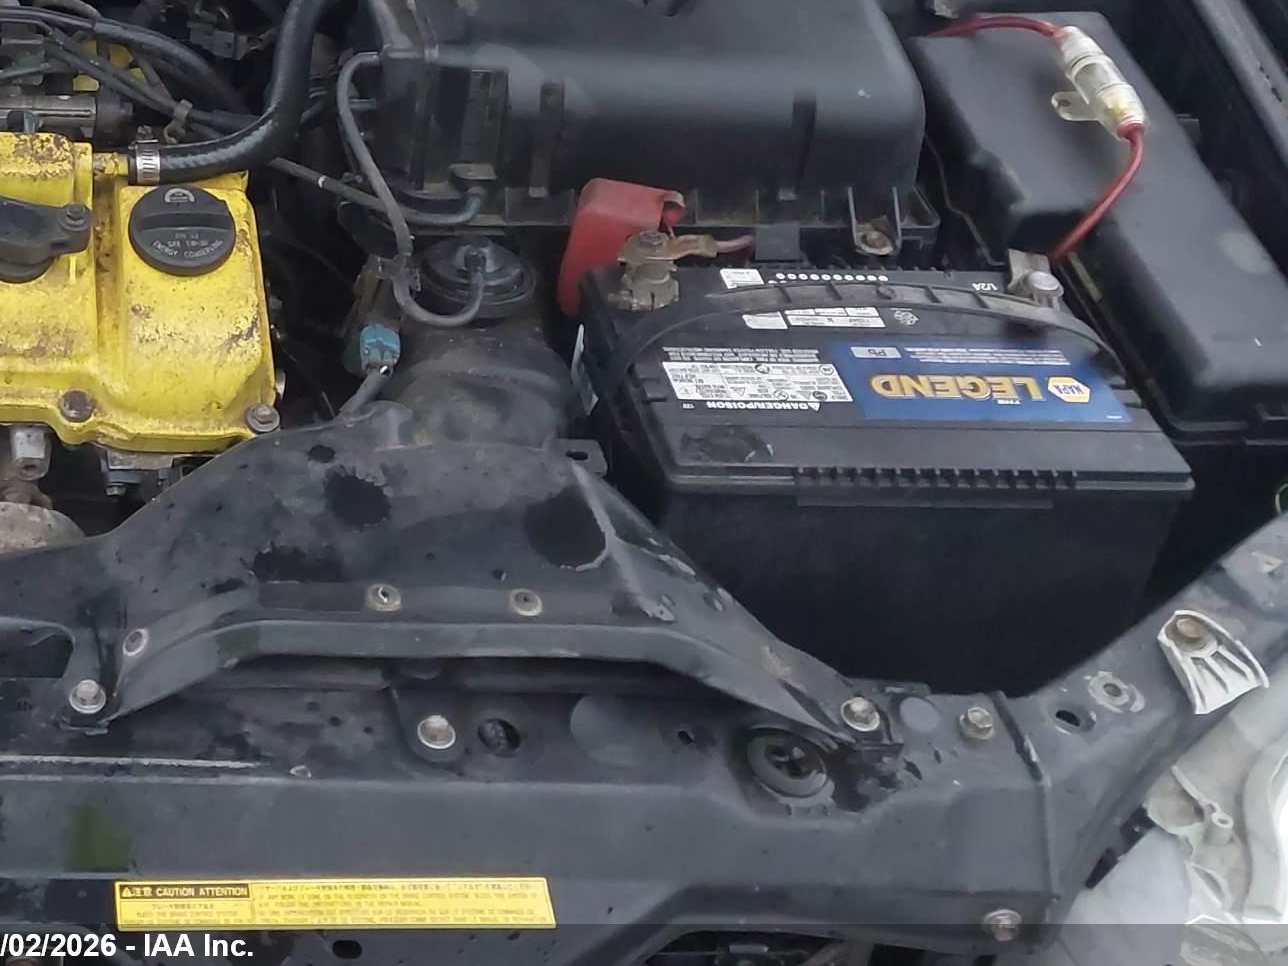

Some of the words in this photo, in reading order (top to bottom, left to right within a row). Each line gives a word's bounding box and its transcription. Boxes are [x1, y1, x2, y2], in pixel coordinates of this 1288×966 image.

[867, 348, 886, 357] Pb
[871, 374, 1047, 402] LEGEND
[1050, 384, 1084, 397] NAPA
[706, 401, 808, 410] DANGER/POISON
[155, 887, 195, 897] CAUTION
[199, 887, 248, 897] ATTENTION
